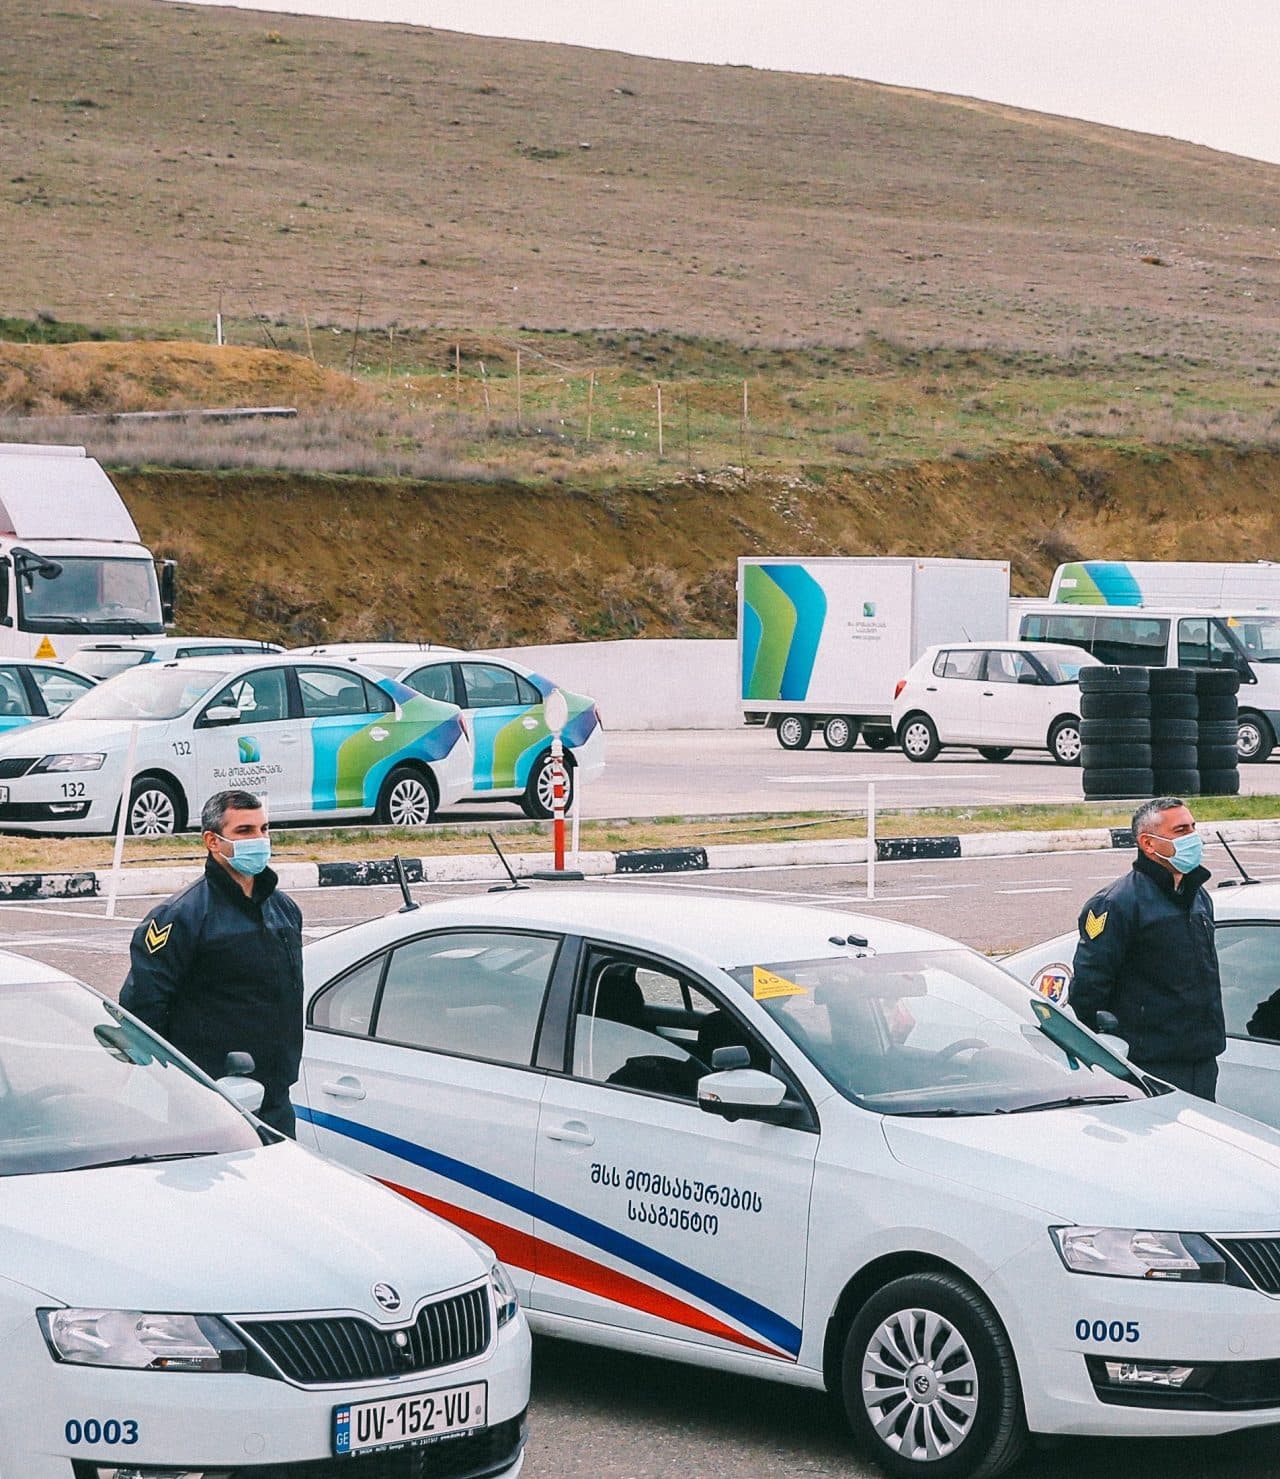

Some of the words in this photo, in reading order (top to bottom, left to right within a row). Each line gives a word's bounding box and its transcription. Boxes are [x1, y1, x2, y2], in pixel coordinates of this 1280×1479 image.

[172, 741, 192, 756] 132
[61, 782, 86, 798] 132
[591, 1163, 620, 1187] შსს
[625, 1169, 762, 1213] მომსახურების
[627, 1200, 719, 1236] სააგენტო
[1075, 1318, 1140, 1343] 0005
[65, 1418, 139, 1445] 0003
[336, 1432, 349, 1445] GE
[356, 1391, 470, 1442] UV-152-VU
